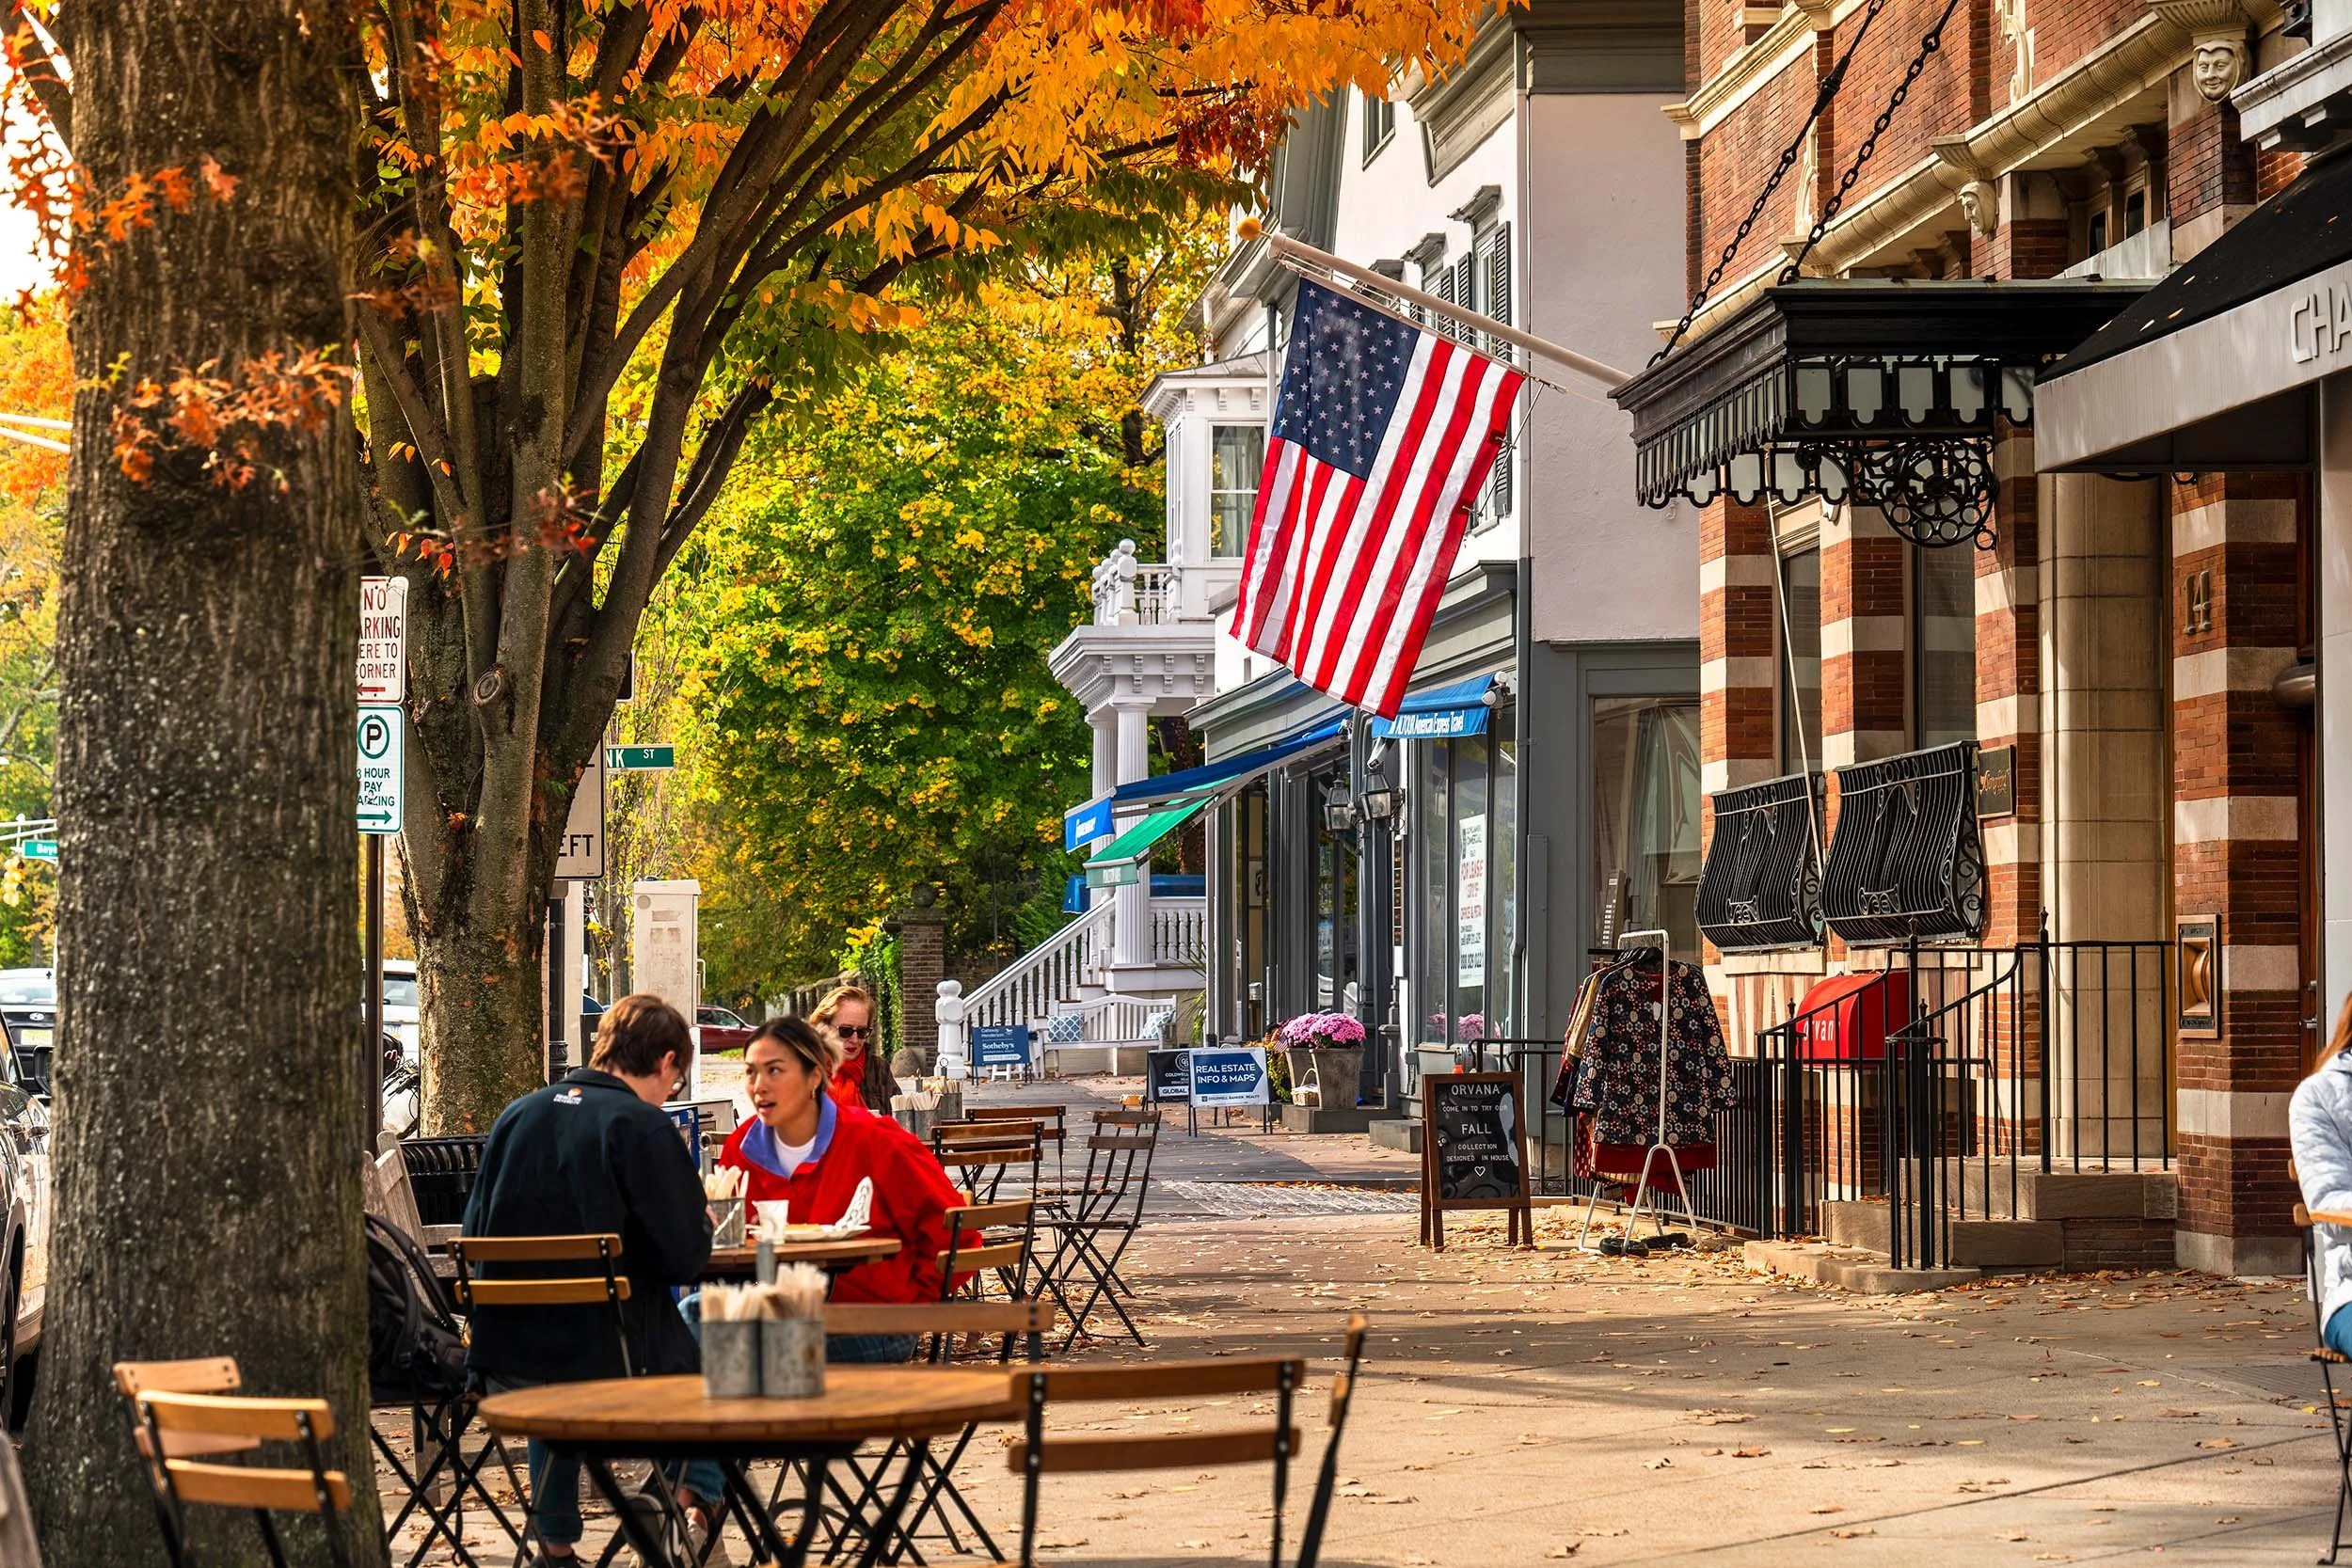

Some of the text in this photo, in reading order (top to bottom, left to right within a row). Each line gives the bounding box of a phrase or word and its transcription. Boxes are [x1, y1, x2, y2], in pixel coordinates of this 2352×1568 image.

[363, 588, 387, 610] NO
[2183, 571, 2211, 635] 14
[359, 616, 401, 640] RKING
[358, 642, 398, 658] ERE TO
[358, 663, 397, 679] ORNER
[1450, 709, 1465, 732] Travel
[366, 723, 383, 751] P
[605, 749, 655, 768] NK ST
[364, 768, 390, 779] HOUR
[364, 782, 383, 792] PAY
[357, 796, 395, 807] AKING
[1196, 1063, 1256, 1073] REAL ESTATE
[1197, 1075, 1220, 1084] INFO
[1229, 1073, 1256, 1083] MAPS
[1451, 1084, 1501, 1096] ORVANA
[1461, 1123, 1492, 1135] FALL
[1446, 1154, 1475, 1163] DESIGNED
